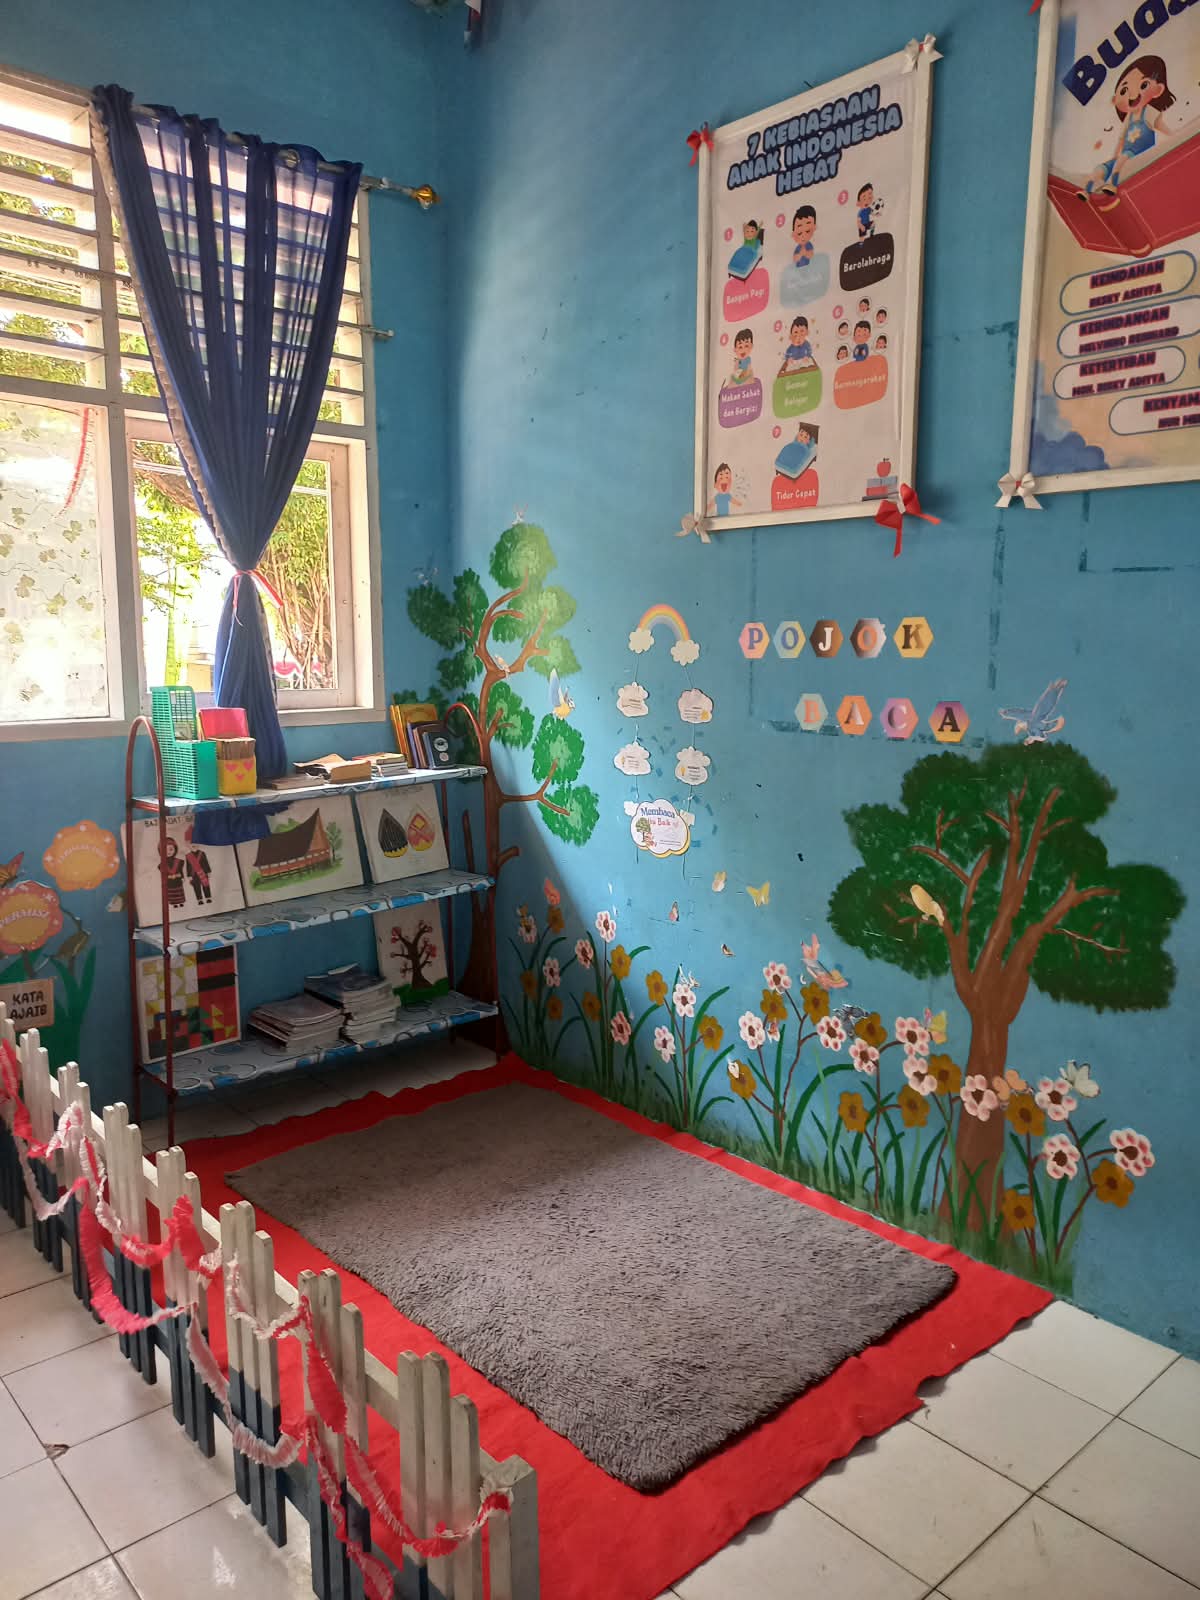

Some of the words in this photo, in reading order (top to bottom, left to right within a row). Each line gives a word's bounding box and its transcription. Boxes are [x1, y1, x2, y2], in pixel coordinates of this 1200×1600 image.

[747, 131, 761, 159] 7
[763, 84, 880, 150] KEBIASAAN
[727, 149, 781, 190] ANAK
[784, 103, 903, 167] INDONESIA
[776, 152, 842, 196] HEBAT
[843, 252, 891, 273] Berolahraga
[1089, 259, 1166, 289] KEINDAHAN
[1079, 352, 1157, 377] KETERTIBAN
[775, 490, 794, 501] Tidur
[794, 488, 817, 500] Cepat
[748, 623, 925, 651] POJOK
[803, 700, 961, 732] BACA
[640, 806, 676, 818] Membaca
[12, 990, 44, 1005] KATA
[10, 1004, 48, 1020] AJAIB
